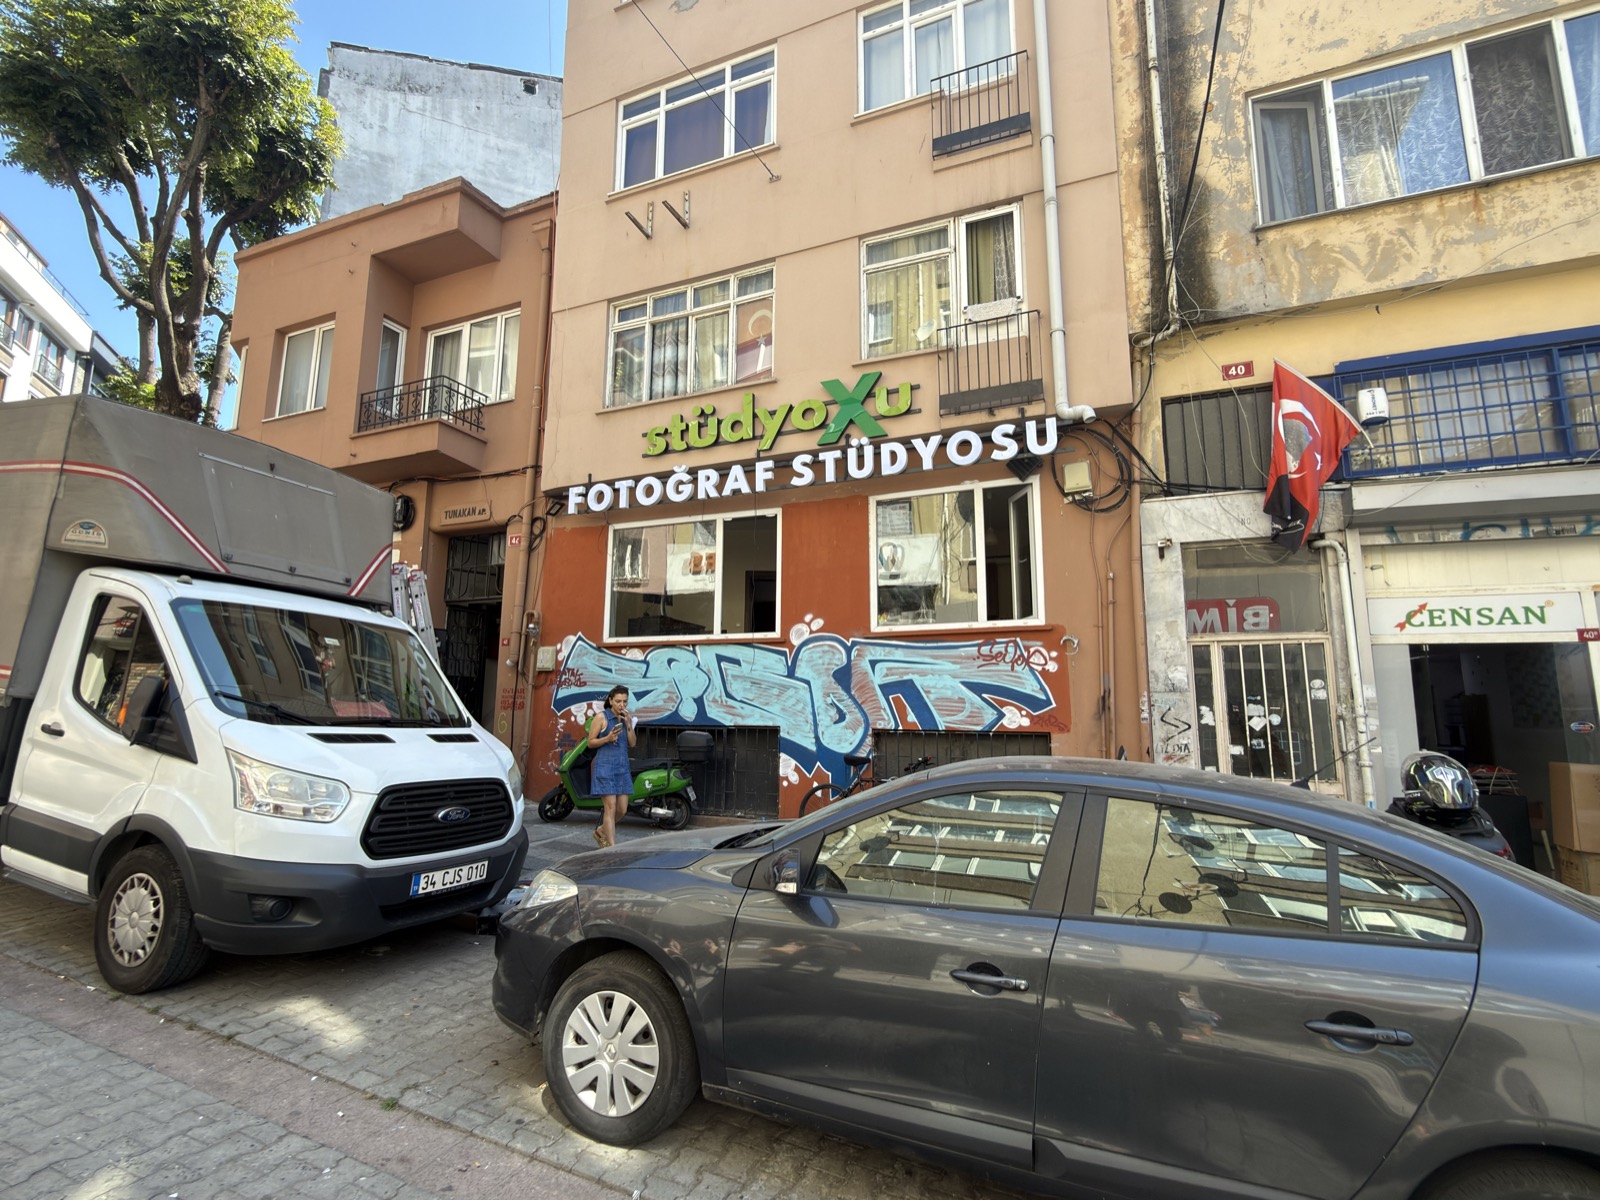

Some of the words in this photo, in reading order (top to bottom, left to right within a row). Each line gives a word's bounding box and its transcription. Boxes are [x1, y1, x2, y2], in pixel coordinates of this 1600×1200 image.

[1228, 365, 1245, 376] 40
[567, 464, 776, 515] FOTOĞRAF
[790, 417, 1059, 487] STÜDYOSU
[447, 809, 466, 821] Ford
[421, 874, 436, 891] 34
[442, 868, 463, 887] CJS
[467, 863, 486, 881] 010
